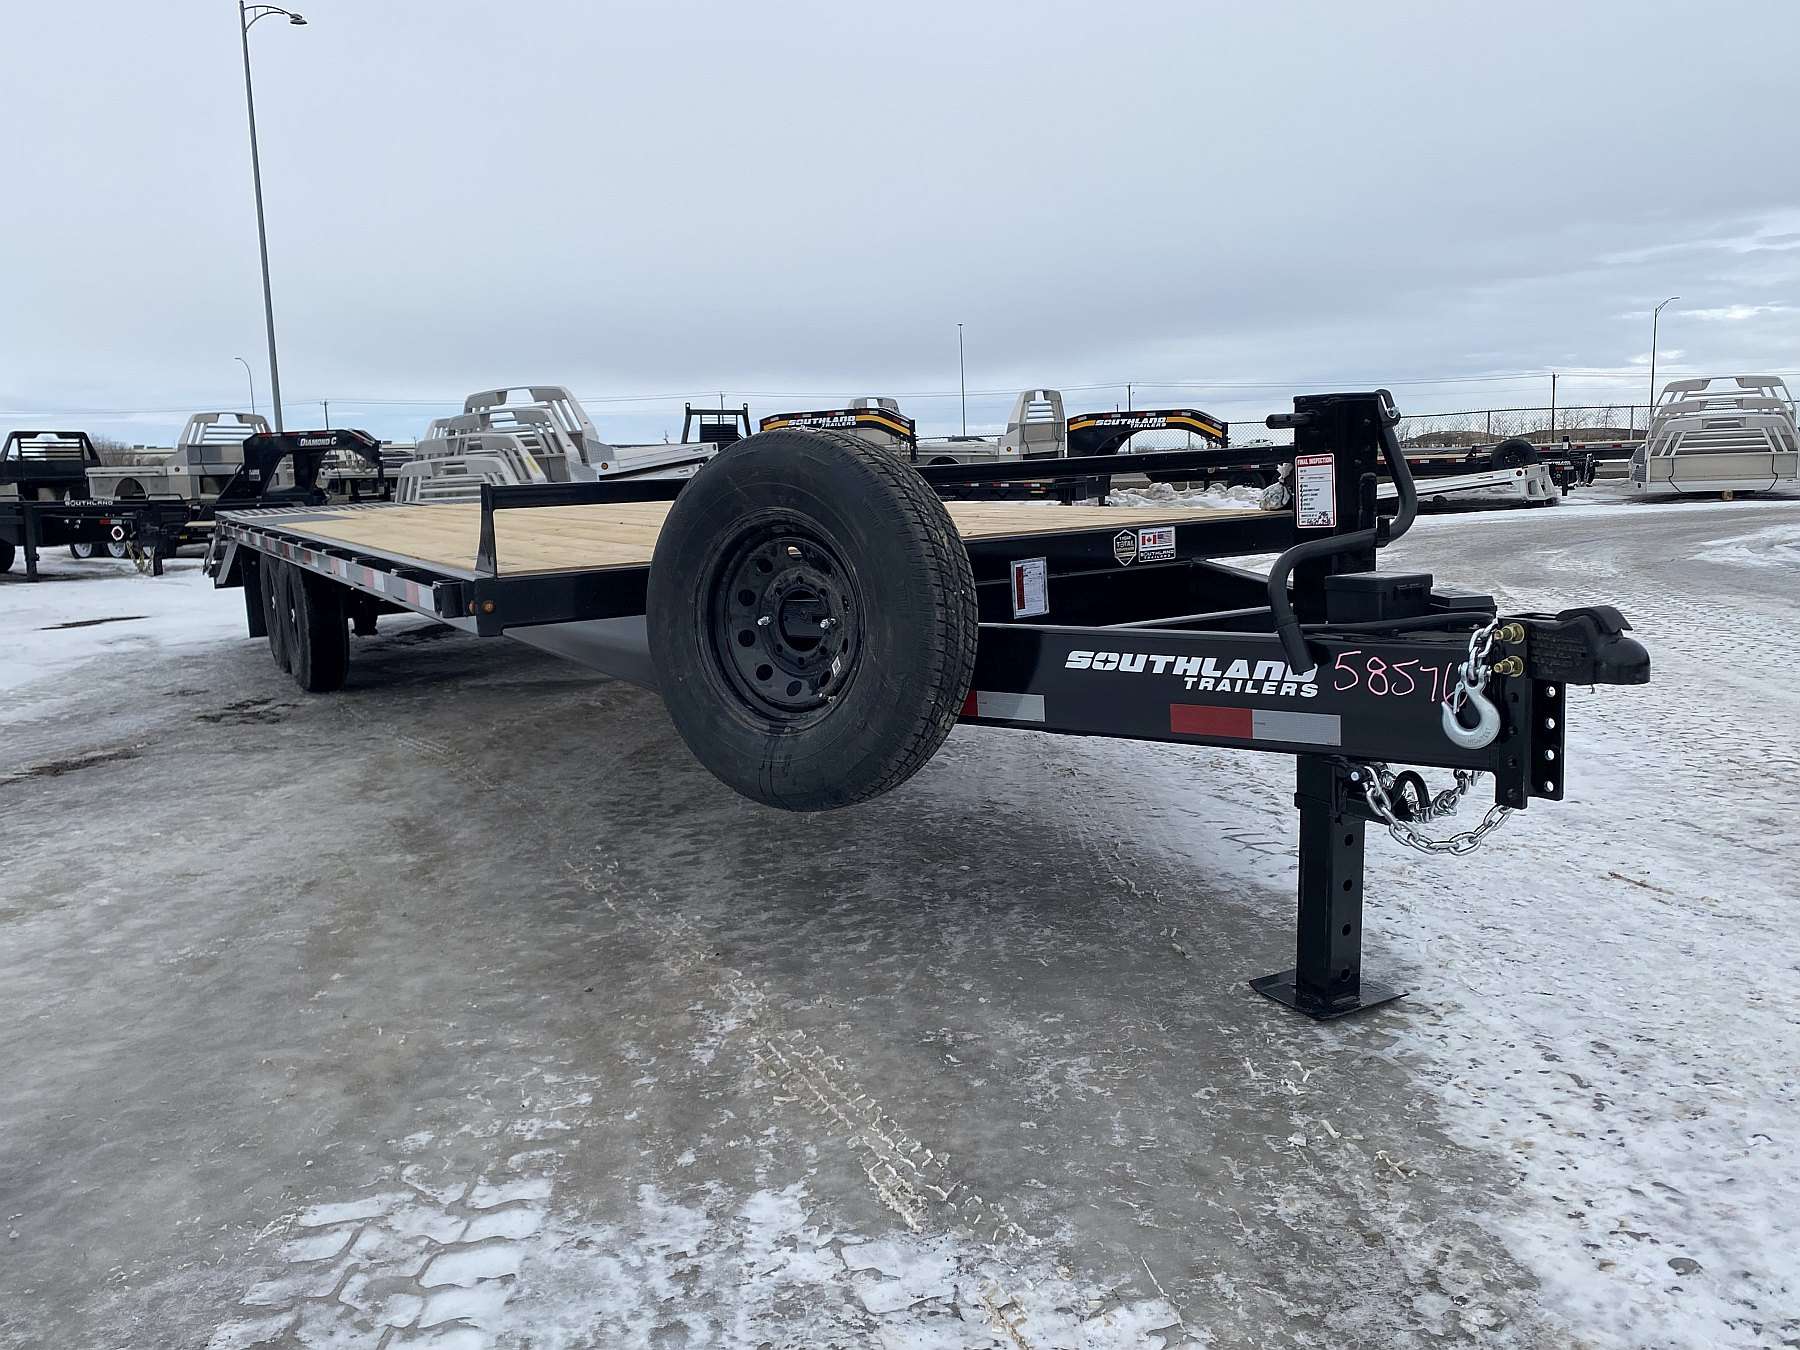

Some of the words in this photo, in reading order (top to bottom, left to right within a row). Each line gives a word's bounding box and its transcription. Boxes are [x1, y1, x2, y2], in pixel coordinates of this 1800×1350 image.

[788, 416, 856, 426] SOUTHLAND
[1095, 417, 1166, 426] SOUTHLAND
[1065, 650, 1318, 682] SOUTHLAND
[1183, 677, 1319, 698] TRAILERS
